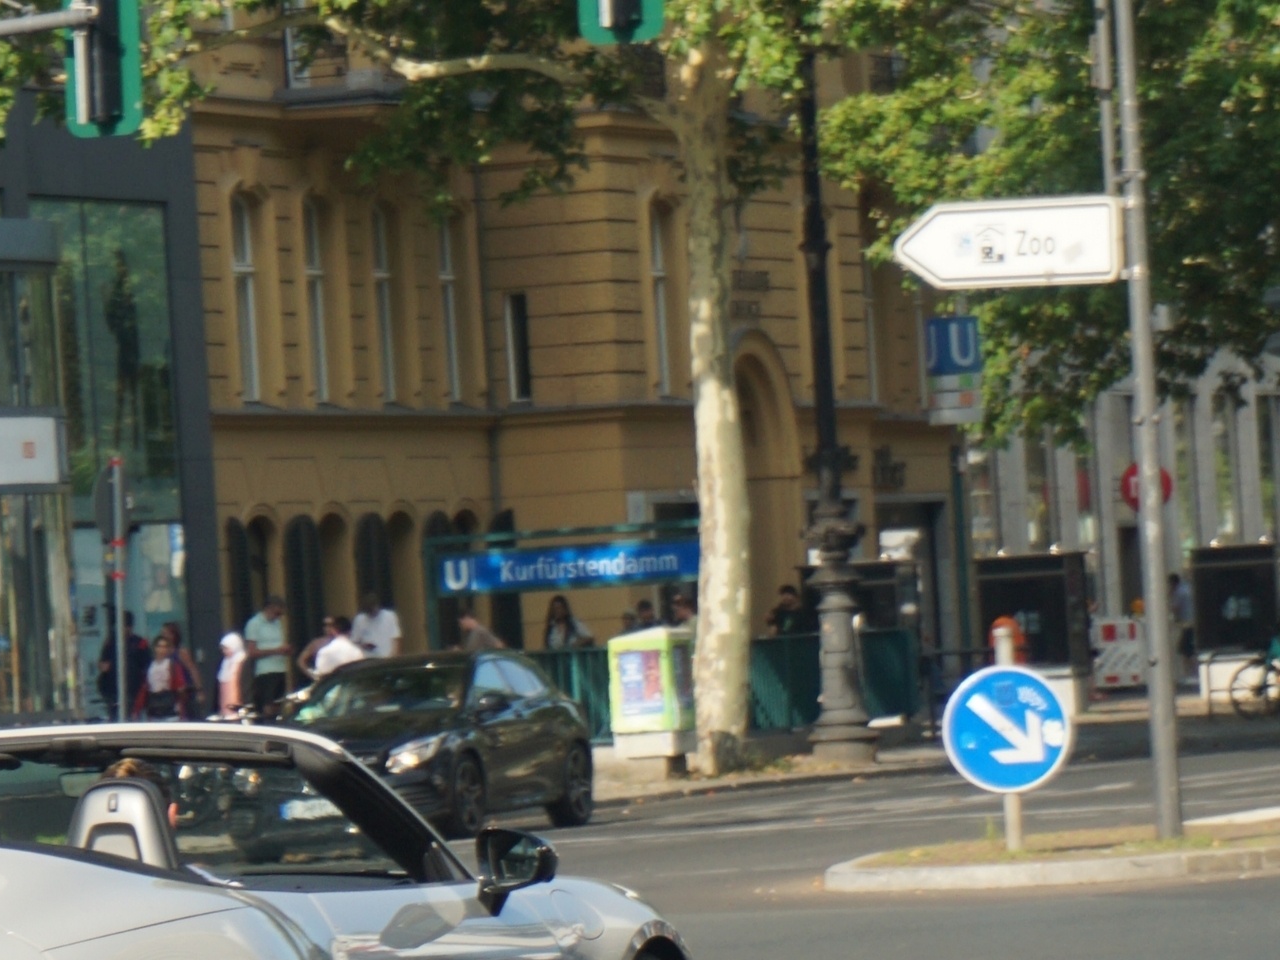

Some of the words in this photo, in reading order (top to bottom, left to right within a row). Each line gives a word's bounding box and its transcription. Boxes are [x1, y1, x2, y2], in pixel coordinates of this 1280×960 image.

[1015, 229, 1056, 257] Zoo
[948, 322, 976, 367] U
[443, 559, 470, 590] U
[500, 552, 679, 583] Kurfürstendamm
